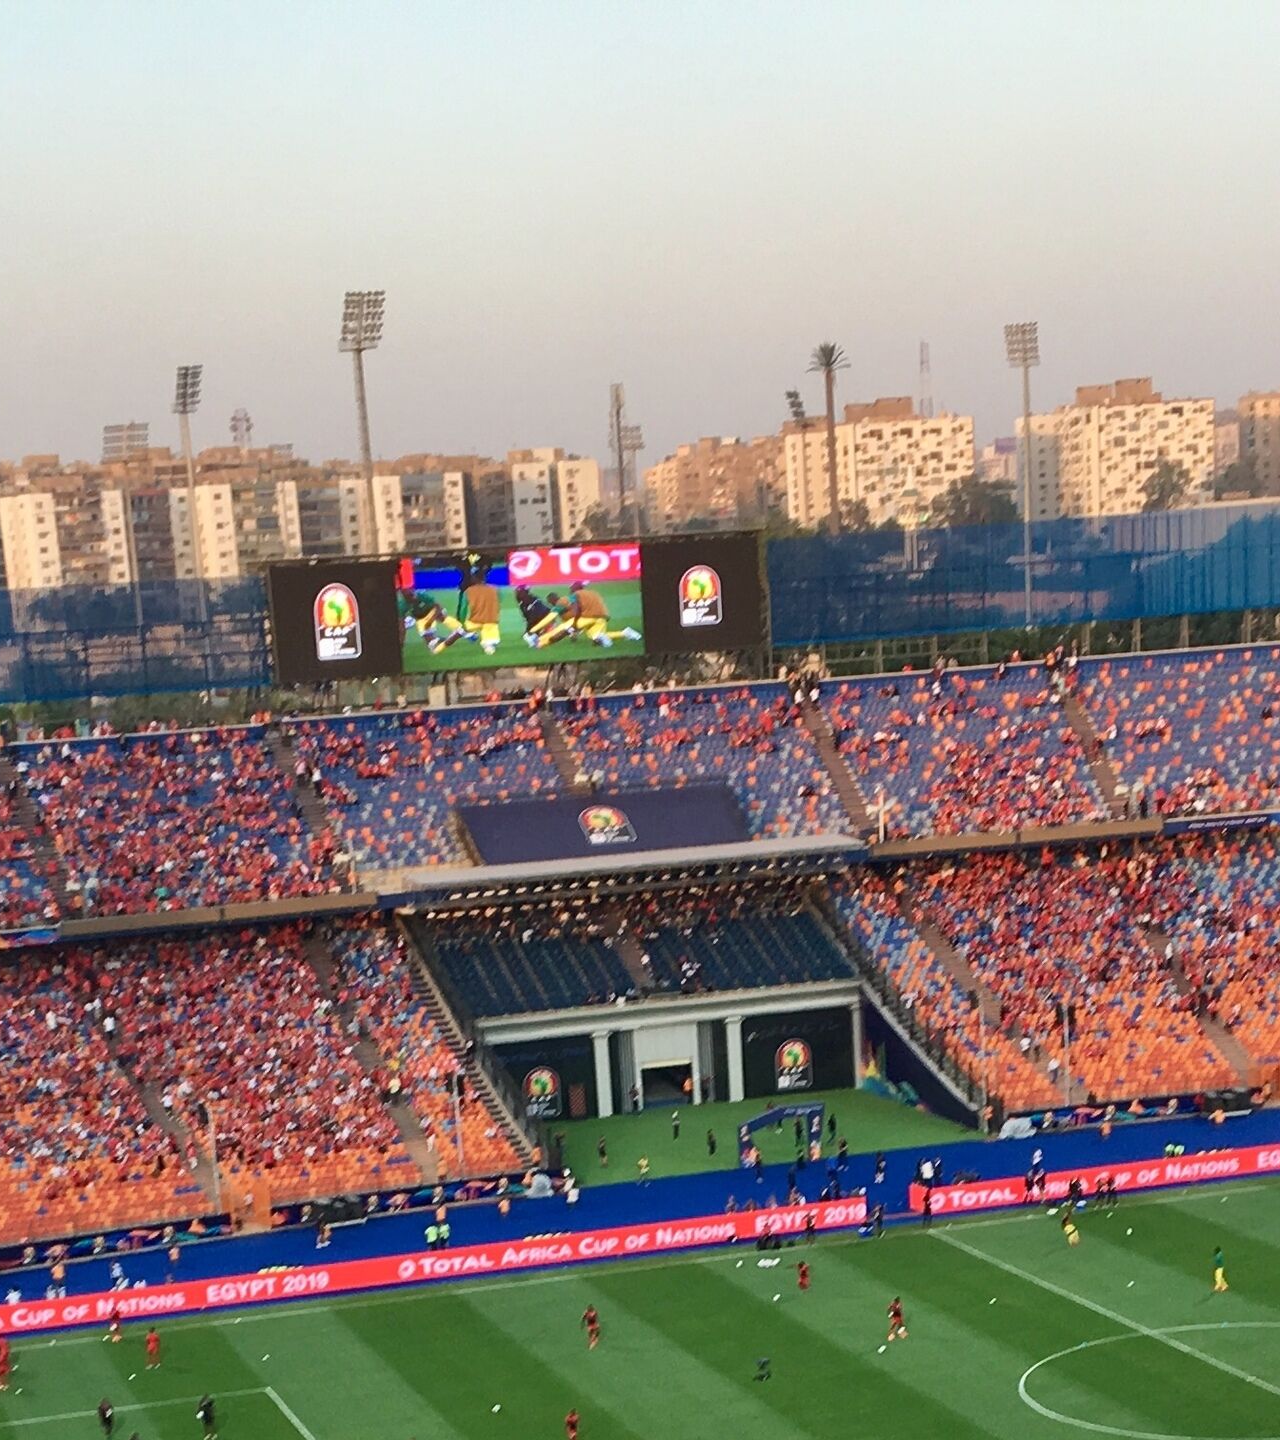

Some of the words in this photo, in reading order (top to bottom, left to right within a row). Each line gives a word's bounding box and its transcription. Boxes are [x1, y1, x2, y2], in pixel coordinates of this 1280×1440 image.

[549, 546, 641, 575] TOT
[948, 1187, 1018, 1210] TOTAL
[1136, 1167, 1159, 1183] OF
[1165, 1157, 1240, 1181] NATIONS
[419, 1254, 495, 1275] TOTAL
[501, 1242, 573, 1265] AFRICA
[578, 1236, 619, 1255] CUP
[624, 1232, 650, 1250] OF
[656, 1221, 737, 1246] NATIONS
[10, 1307, 56, 1328] CUP
[61, 1304, 90, 1321] OF
[96, 1292, 187, 1316] NATIONS
[205, 1277, 277, 1303] EGYPT
[282, 1271, 330, 1293] 2019
